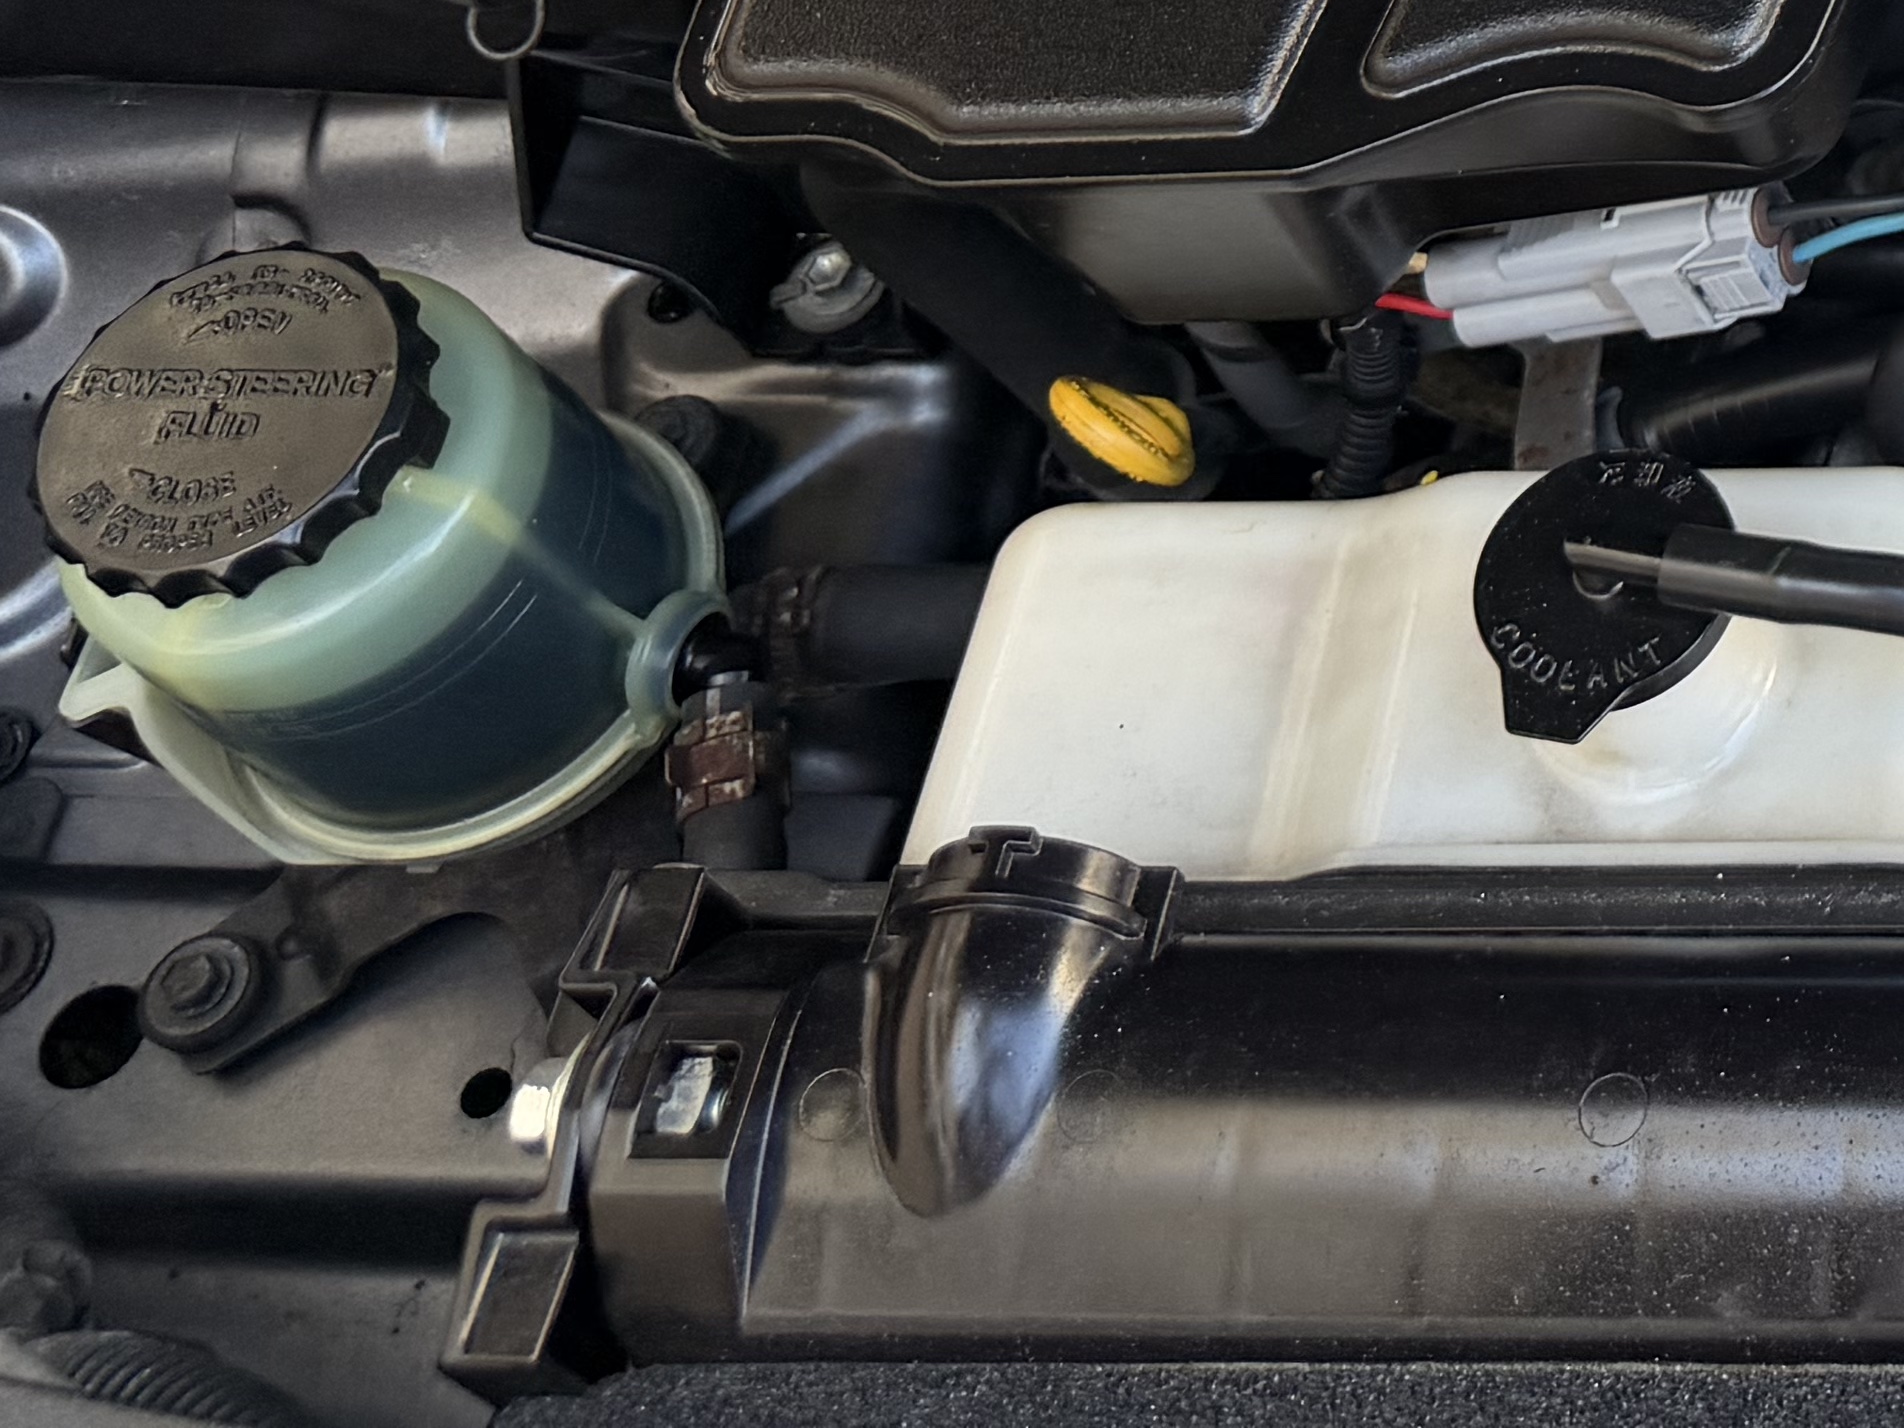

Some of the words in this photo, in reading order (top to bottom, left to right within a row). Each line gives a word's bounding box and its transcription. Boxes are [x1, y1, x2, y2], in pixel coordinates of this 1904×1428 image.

[82, 368, 203, 400] POWER
[204, 365, 381, 399] STEERING
[156, 409, 262, 446] FLUID
[147, 470, 237, 502] CLOSE
[1490, 622, 1661, 692] COOLANT
